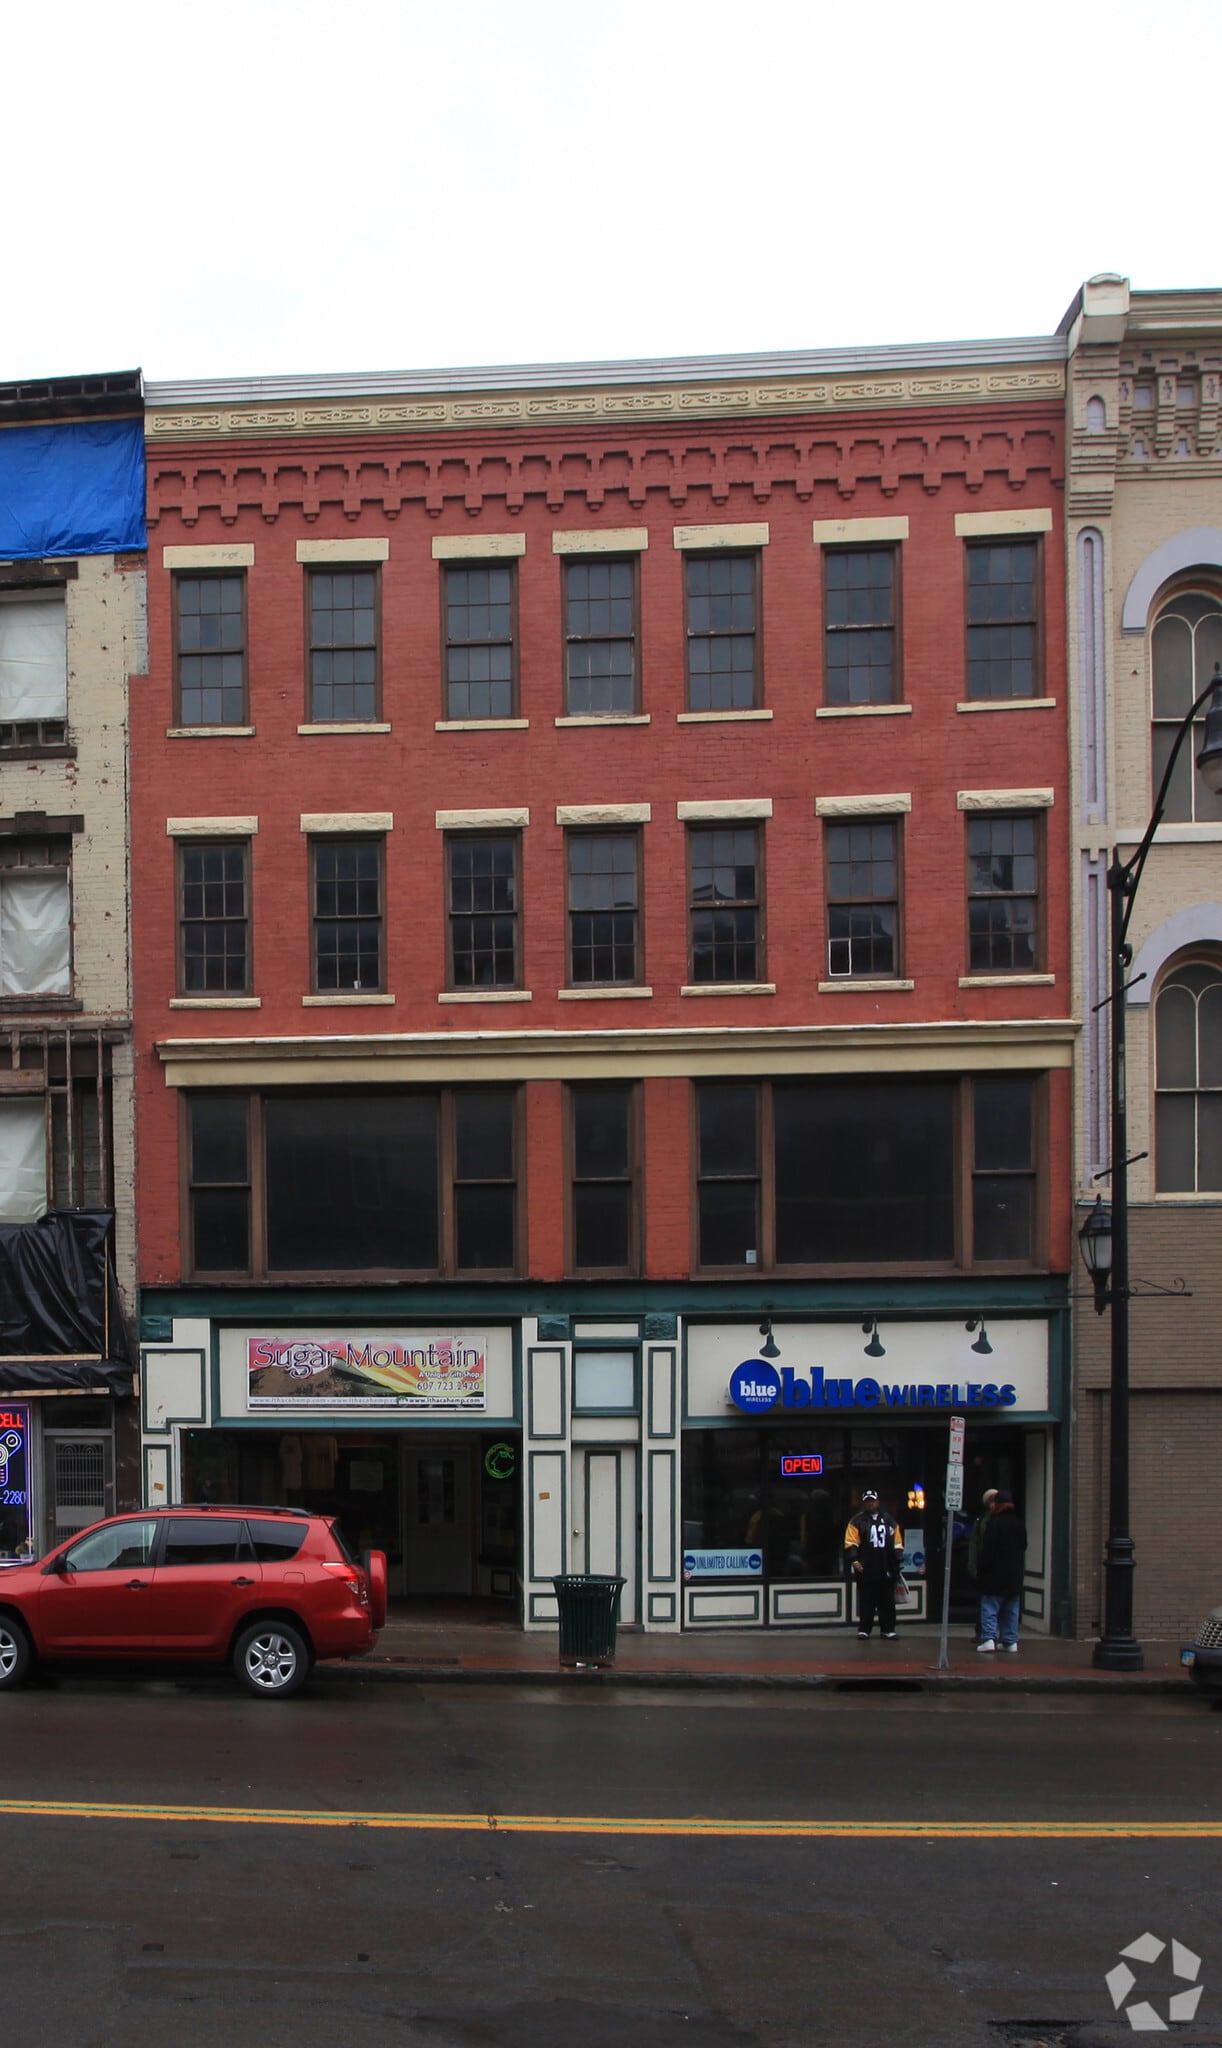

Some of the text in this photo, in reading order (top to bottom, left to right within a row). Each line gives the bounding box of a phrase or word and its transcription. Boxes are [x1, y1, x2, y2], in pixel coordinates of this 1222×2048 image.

[254, 1341, 479, 1379] Sugar Mountain
[425, 1371, 448, 1380] Unique
[463, 1371, 480, 1380] Shop
[740, 1380, 777, 1397] blue
[780, 1366, 1017, 1408] blue WIRELESS
[784, 1459, 820, 1473] OPEN
[870, 1524, 886, 1548] 43
[726, 1555, 748, 1568] CALLING
